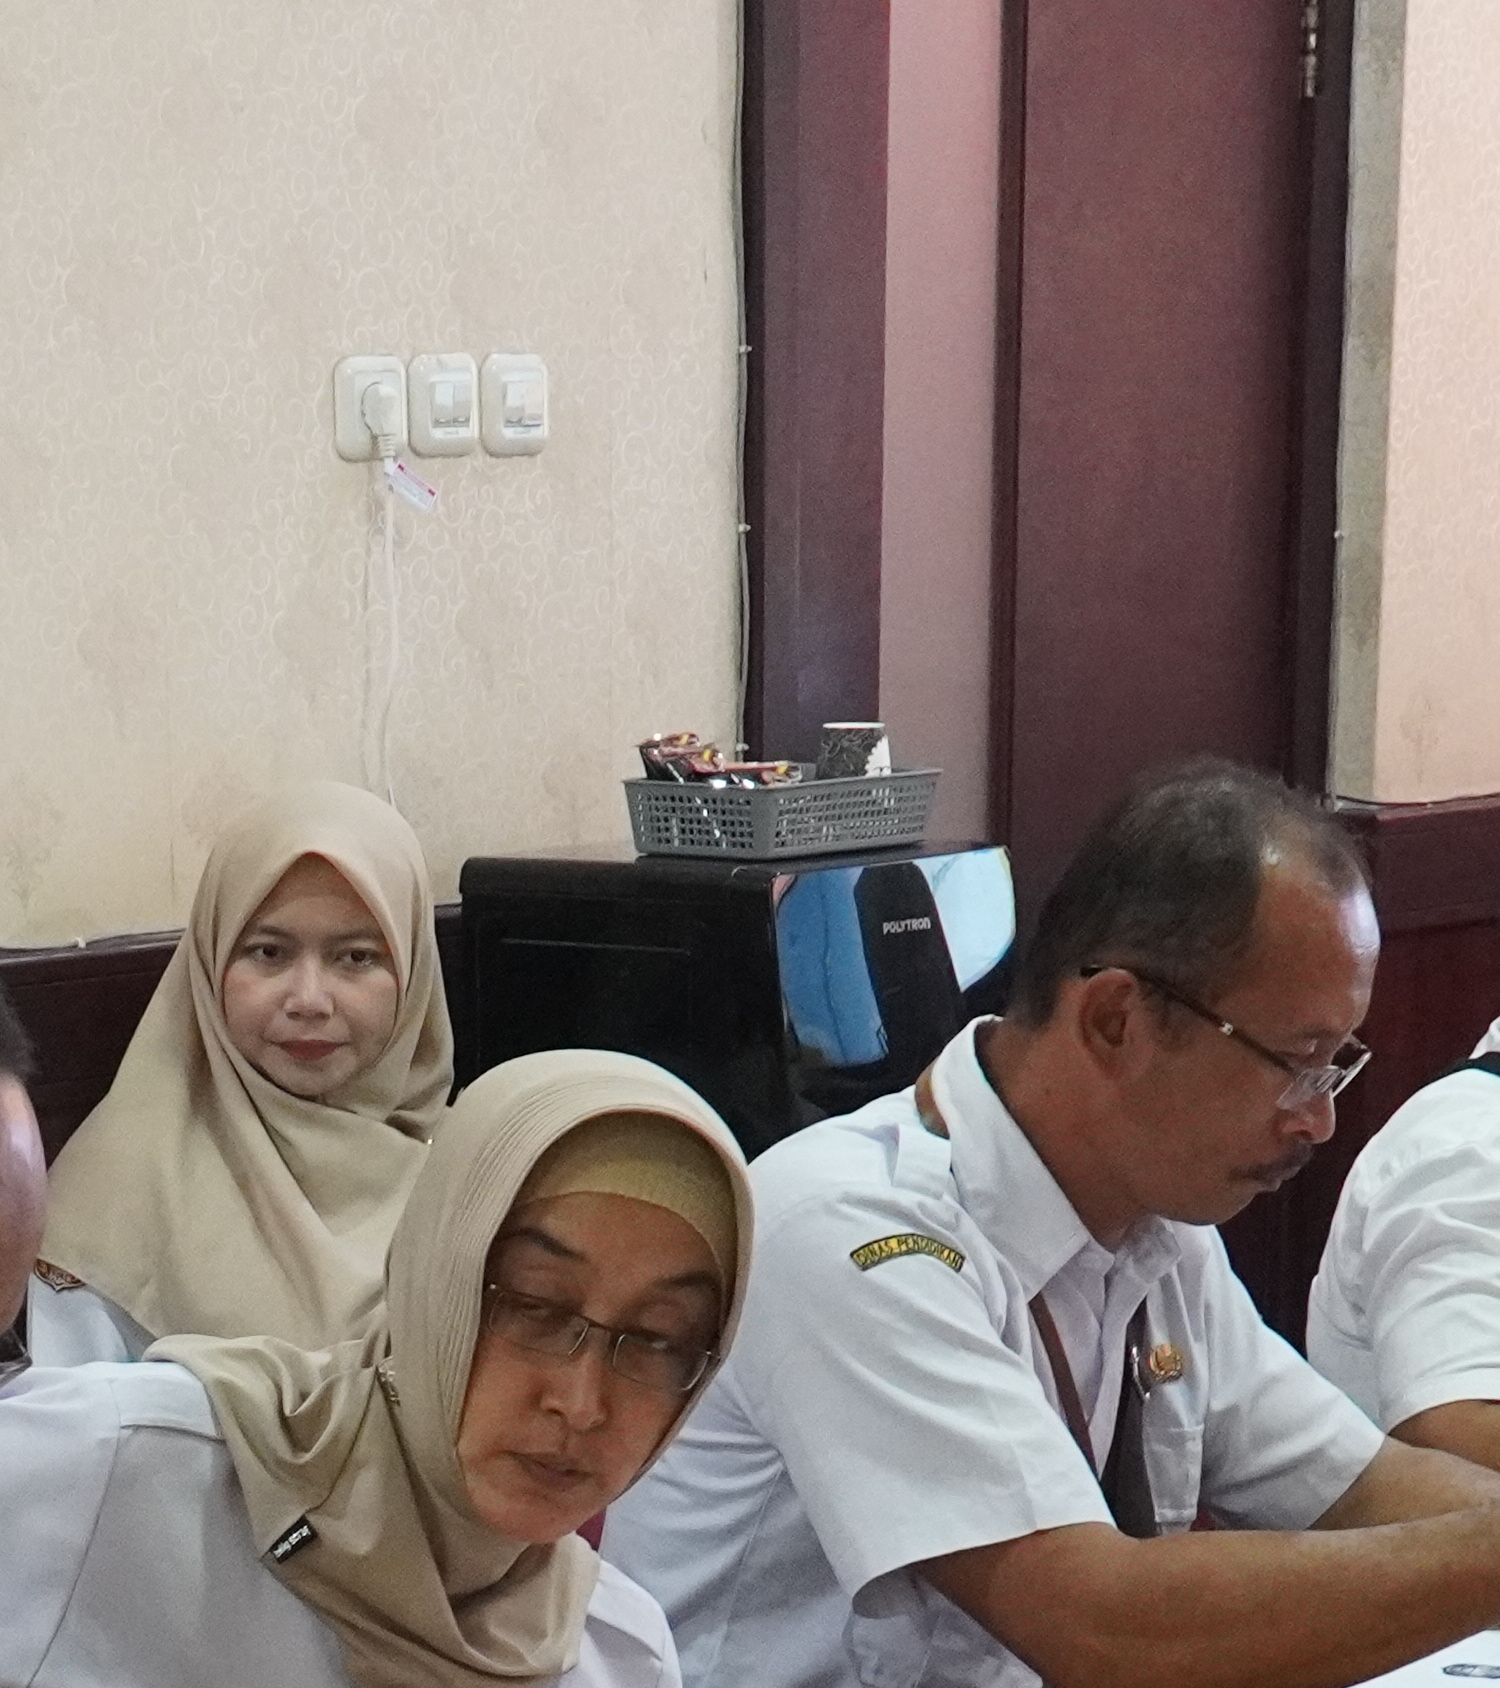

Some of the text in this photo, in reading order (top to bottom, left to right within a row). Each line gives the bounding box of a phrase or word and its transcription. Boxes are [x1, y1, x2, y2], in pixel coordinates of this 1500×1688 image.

[882, 916, 932, 936] POLYTRON
[855, 1236, 960, 1270] DINAS PENDIDIKAN
